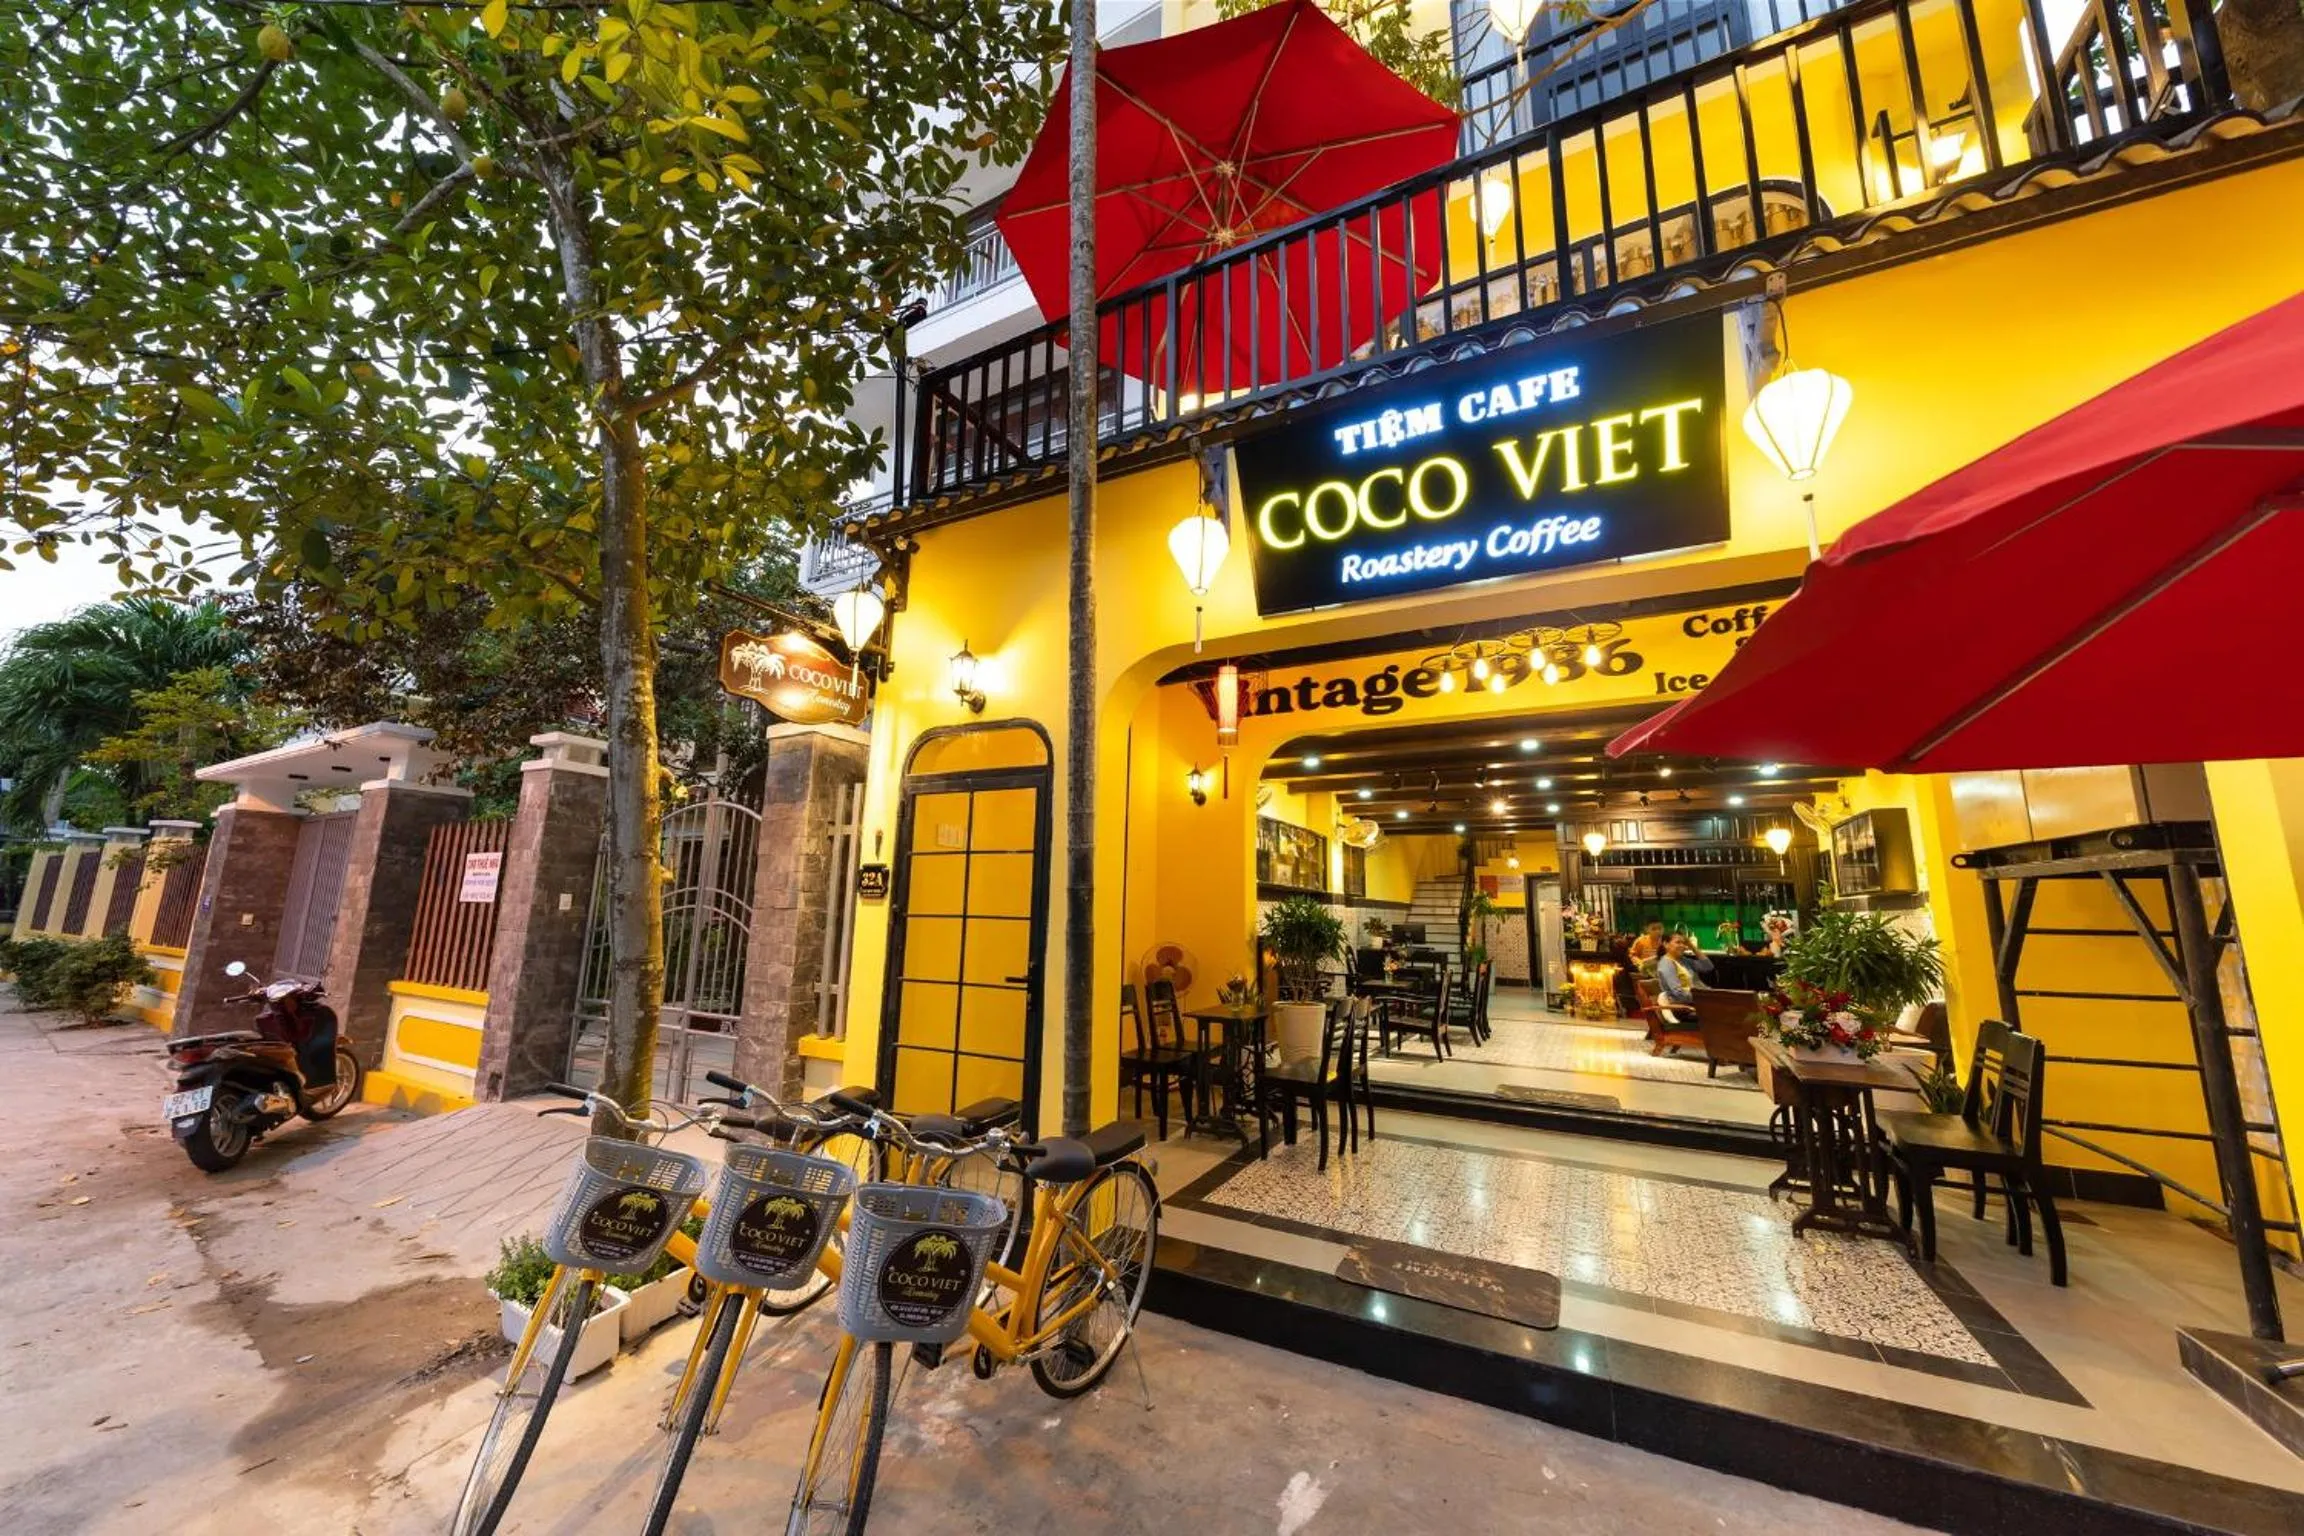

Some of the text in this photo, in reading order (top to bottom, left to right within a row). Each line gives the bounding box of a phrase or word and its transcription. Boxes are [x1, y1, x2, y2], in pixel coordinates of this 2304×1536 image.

[1334, 366, 1580, 455] TIỆM CAFE
[1258, 397, 1703, 549] COCO VIET
[1341, 515, 1601, 583] Roastery Coffee
[1654, 671, 1709, 694] Ice
